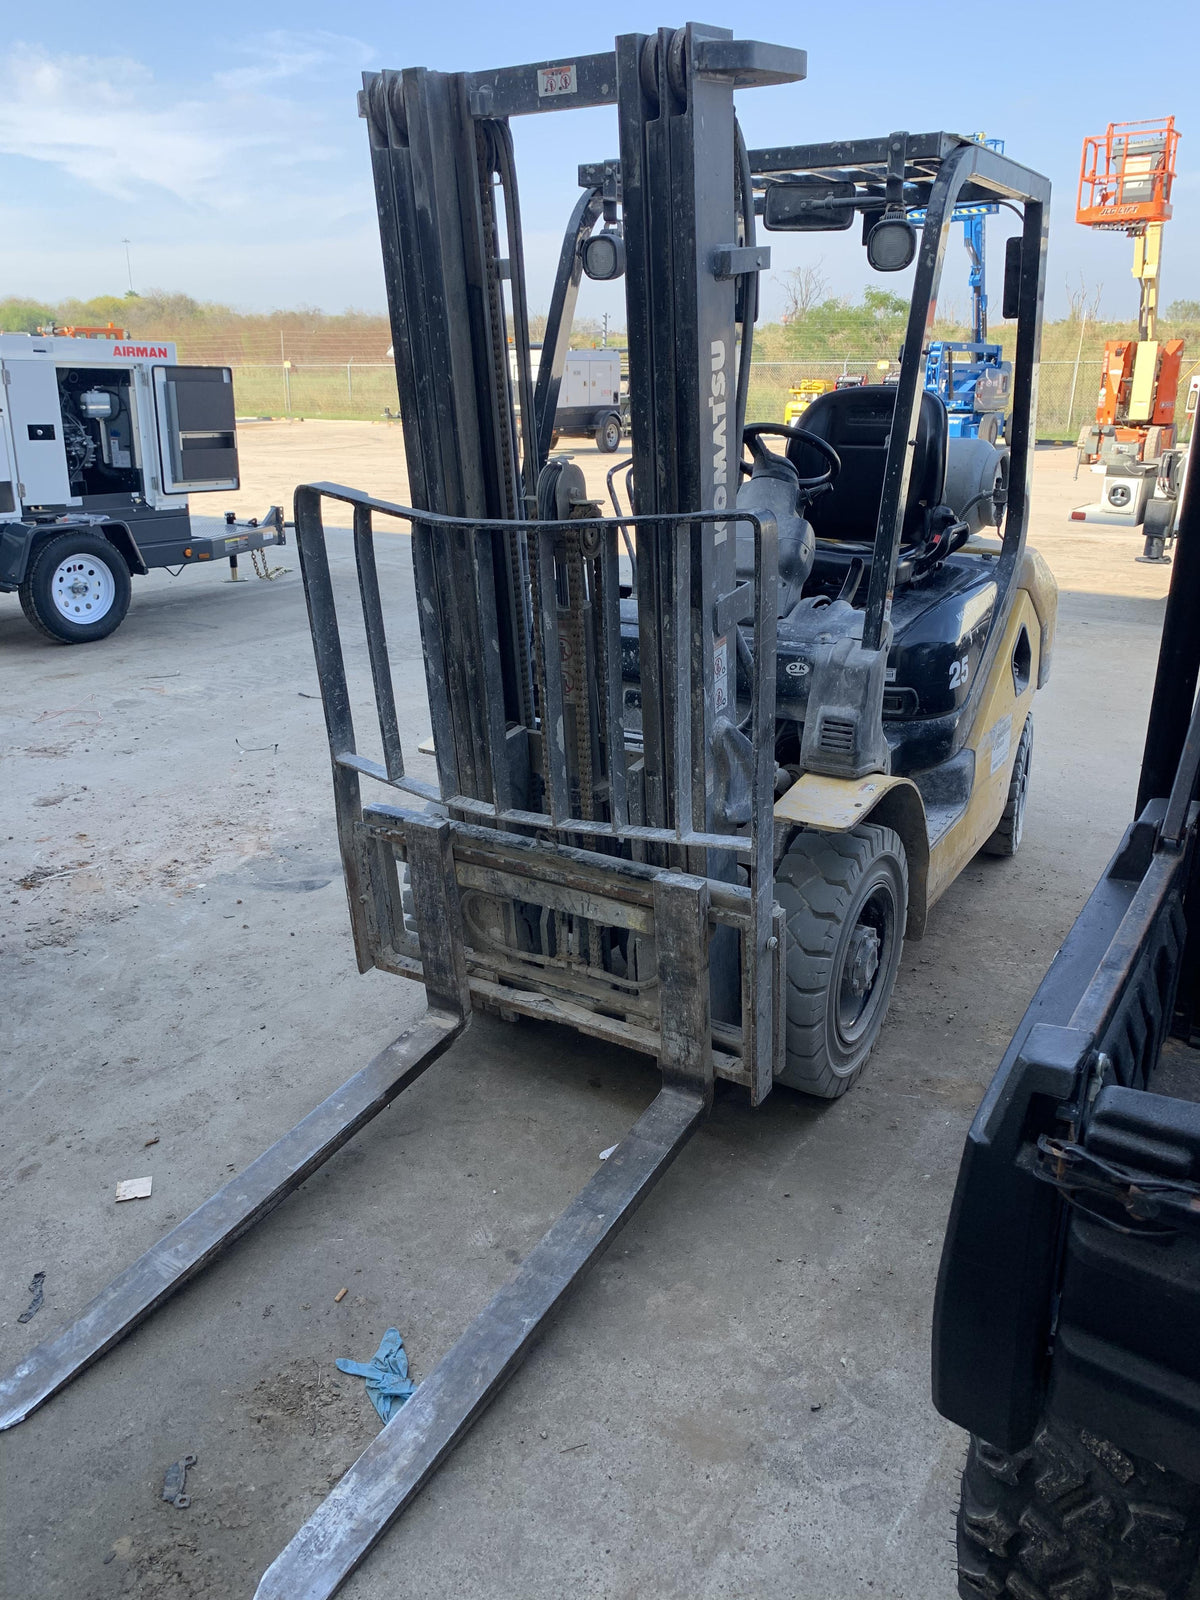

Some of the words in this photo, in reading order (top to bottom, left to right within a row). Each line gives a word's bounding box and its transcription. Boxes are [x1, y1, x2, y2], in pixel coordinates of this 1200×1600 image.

[1099, 207, 1117, 216] JLG
[113, 346, 167, 358] AIRMAN
[708, 339, 728, 546] KOMATSU
[949, 655, 968, 690] 25
